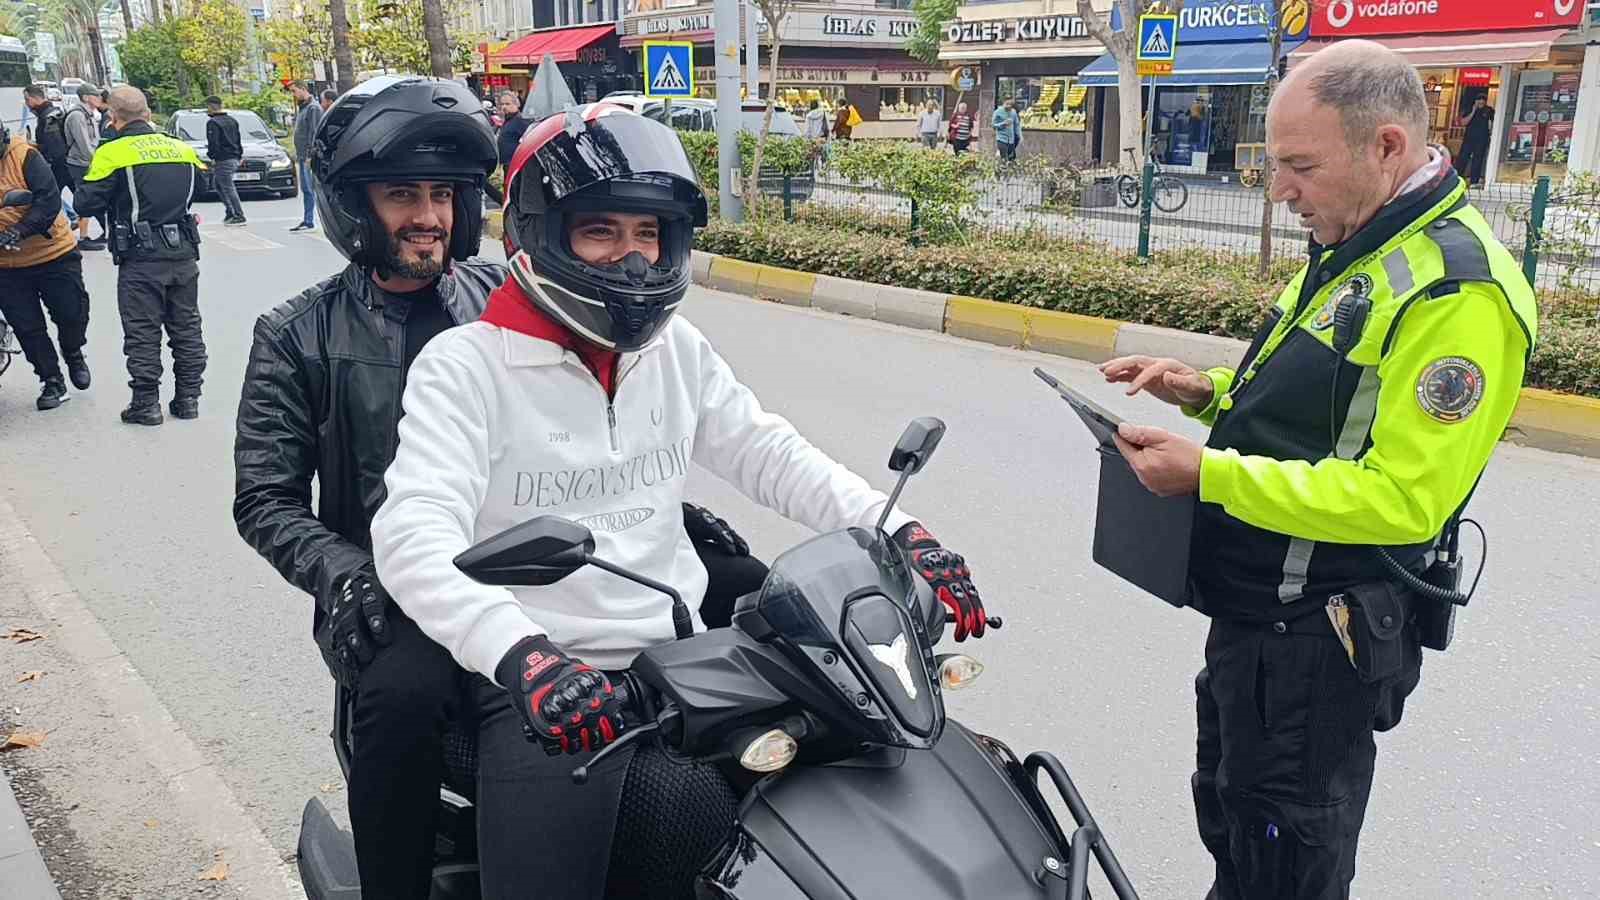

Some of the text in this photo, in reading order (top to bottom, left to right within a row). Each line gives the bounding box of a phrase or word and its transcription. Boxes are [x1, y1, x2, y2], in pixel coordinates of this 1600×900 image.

[1358, 0, 1438, 16] vodafone
[901, 71, 930, 81] SAAT
[549, 431, 571, 443] 1998
[513, 463, 606, 508] DESIGN
